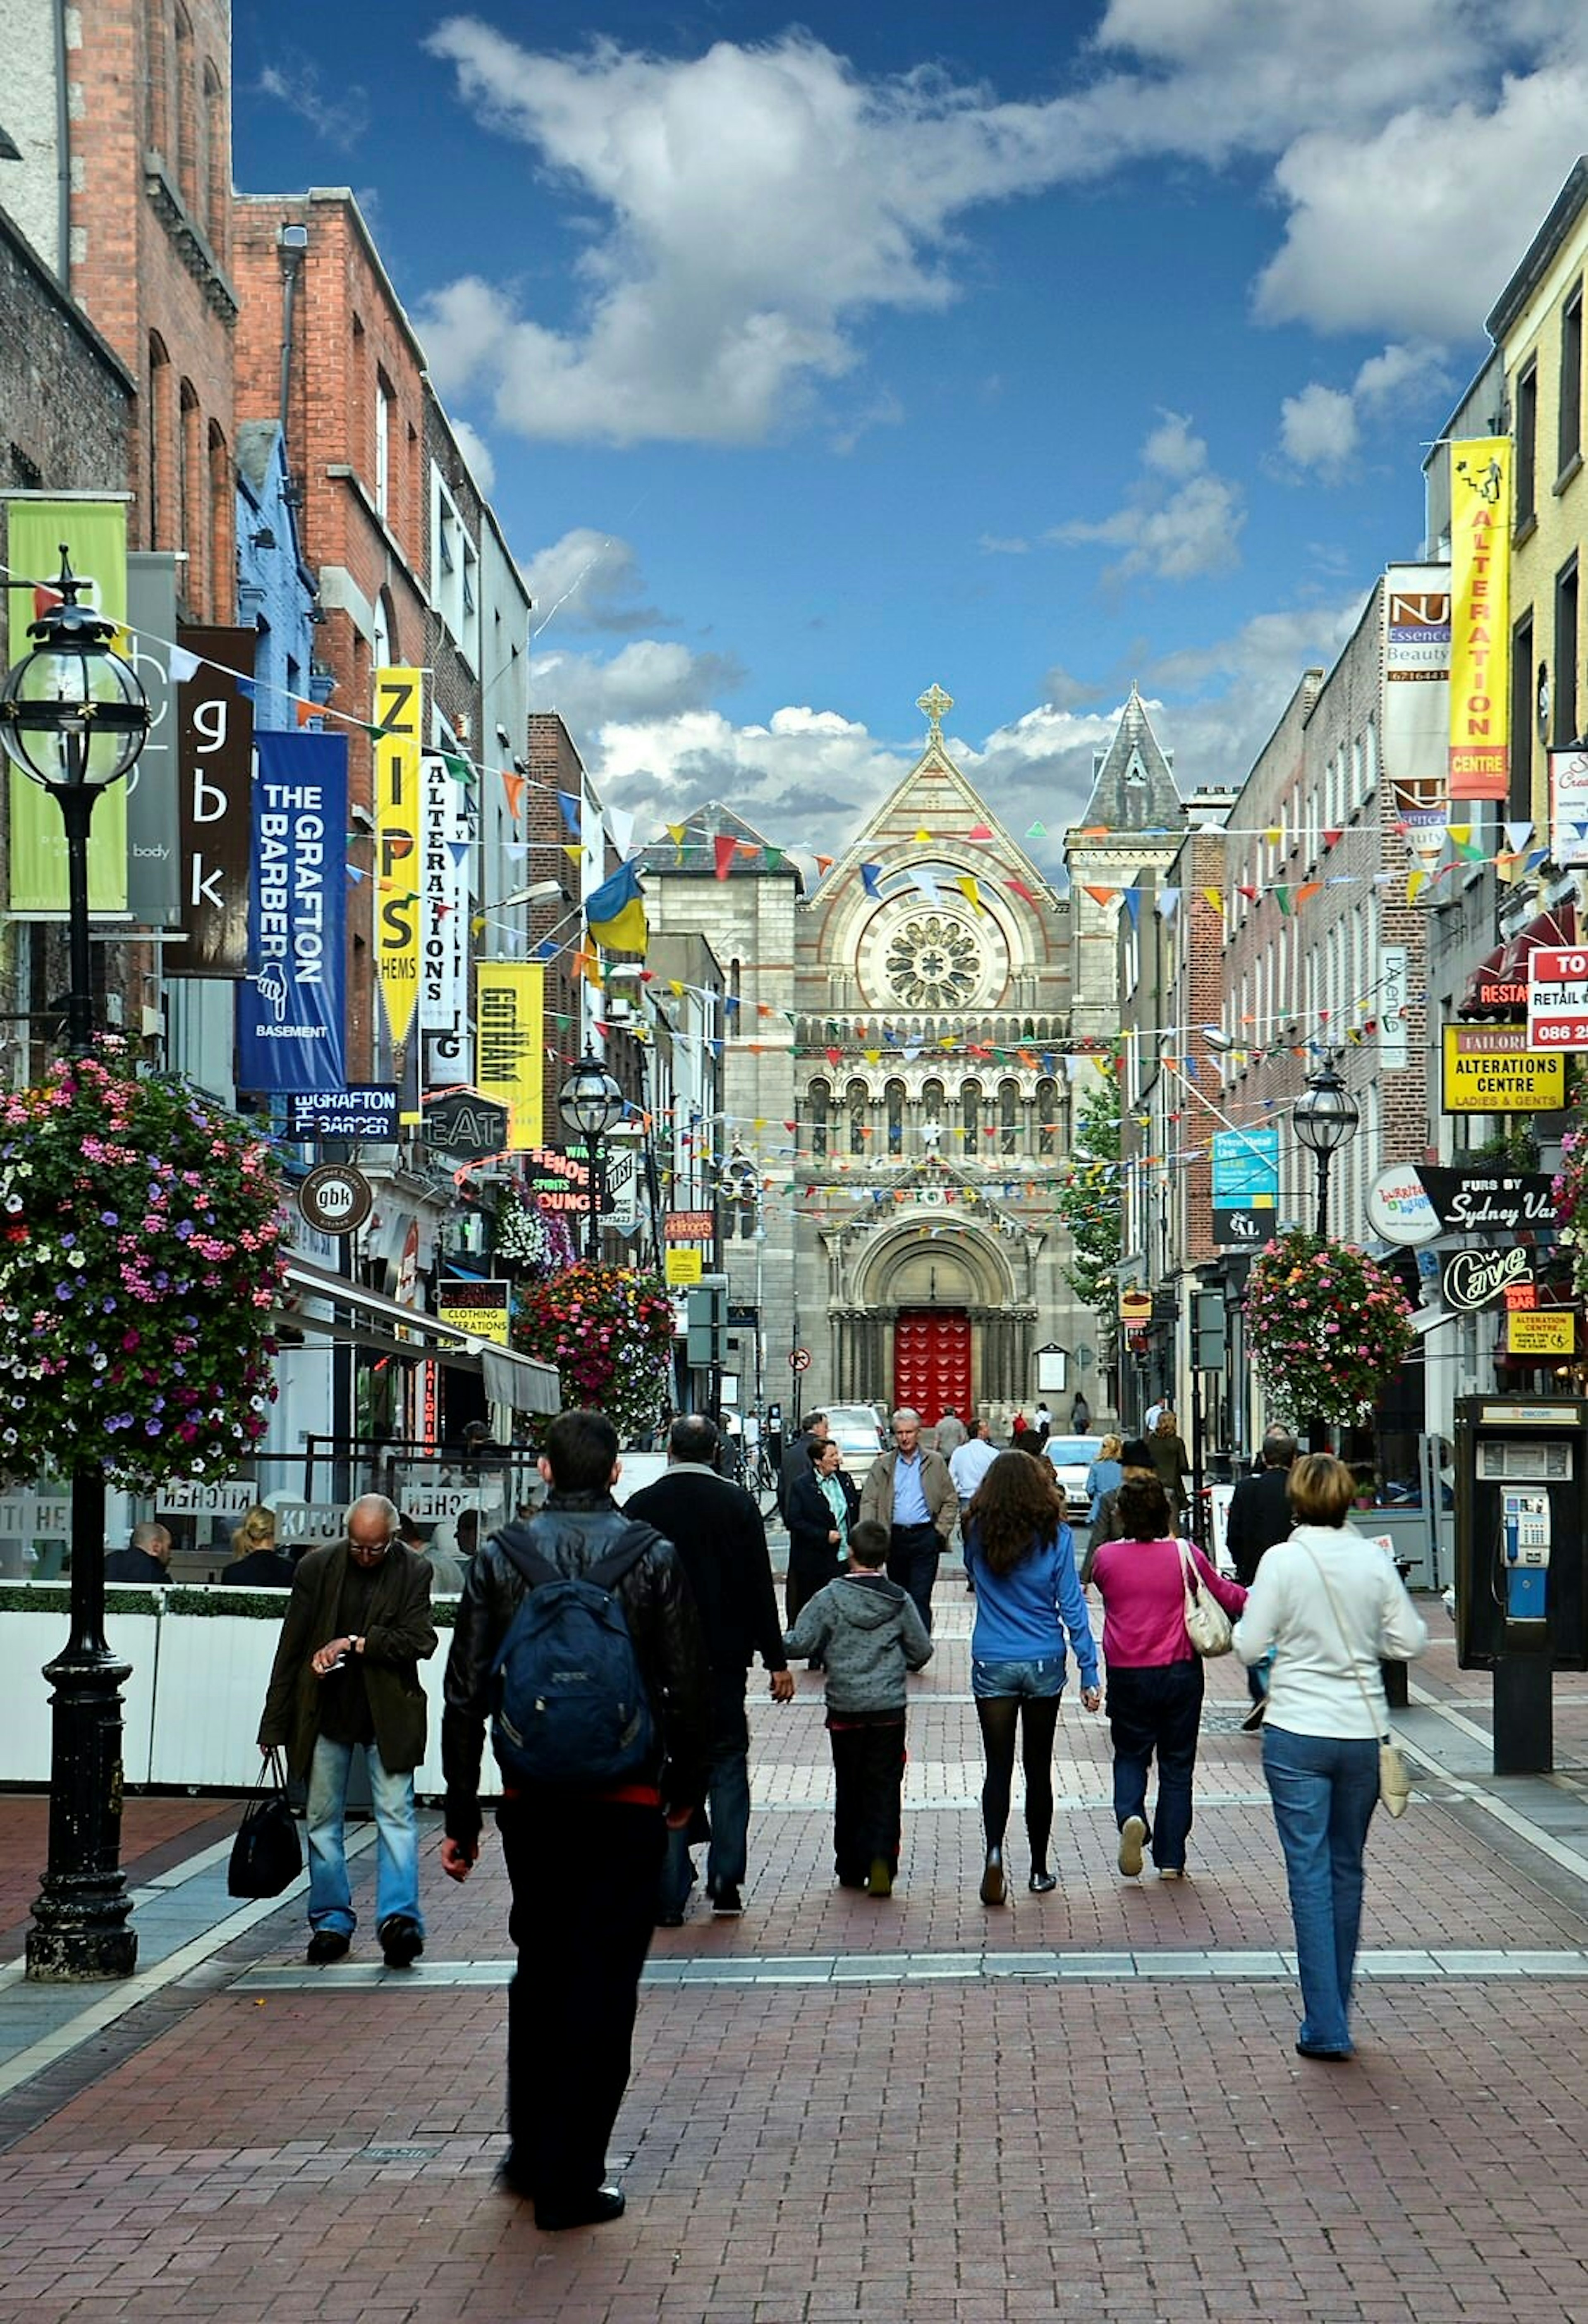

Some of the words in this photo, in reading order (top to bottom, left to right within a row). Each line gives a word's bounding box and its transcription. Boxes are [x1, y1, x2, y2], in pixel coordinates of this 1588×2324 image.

[1392, 596, 1449, 626] NU
[1468, 510, 1492, 736] ALTERATION
[1388, 646, 1449, 665] Beauty
[1453, 755, 1503, 772] CENTRE
[263, 784, 322, 810] THE
[380, 685, 414, 948] ZIPS
[133, 843, 170, 860] body
[260, 814, 289, 958] BARBER
[425, 767, 445, 1001] ALTERATIONS
[294, 814, 323, 983] GRAFTON
[382, 957, 416, 979] HEMS
[1556, 955, 1586, 974] TO
[1481, 984, 1530, 1003] RESTA
[1534, 992, 1579, 1006] RETAIL
[256, 1024, 328, 1038] BASEMENT
[481, 988, 534, 1082] GOTHAM
[1538, 1025, 1571, 1041] 086
[1574, 1025, 1588, 1040] 2
[1465, 1035, 1526, 1050] TAILORI
[1456, 1059, 1557, 1074] ALTERATIONS
[1478, 1078, 1534, 1092] CENTRE
[313, 1092, 396, 1110] GRAFTON
[1455, 1096, 1497, 1106] LADIES
[1502, 1096, 1511, 1106] &
[1516, 1096, 1557, 1106] GENTS
[295, 1095, 315, 1133] THE
[428, 1106, 501, 1147] EAT
[532, 1179, 571, 1191] SPIRITS
[1461, 1180, 1498, 1192] FURS
[1503, 1178, 1523, 1191] BY
[319, 1188, 349, 1208] gbk
[1444, 1193, 1520, 1228] Sydney
[1523, 1192, 1558, 1218] Var
[1443, 1247, 1534, 1310] Cave
[1504, 1286, 1535, 1297] WINE
[1507, 1297, 1535, 1309] BAR
[448, 1310, 497, 1319] CLOTHING
